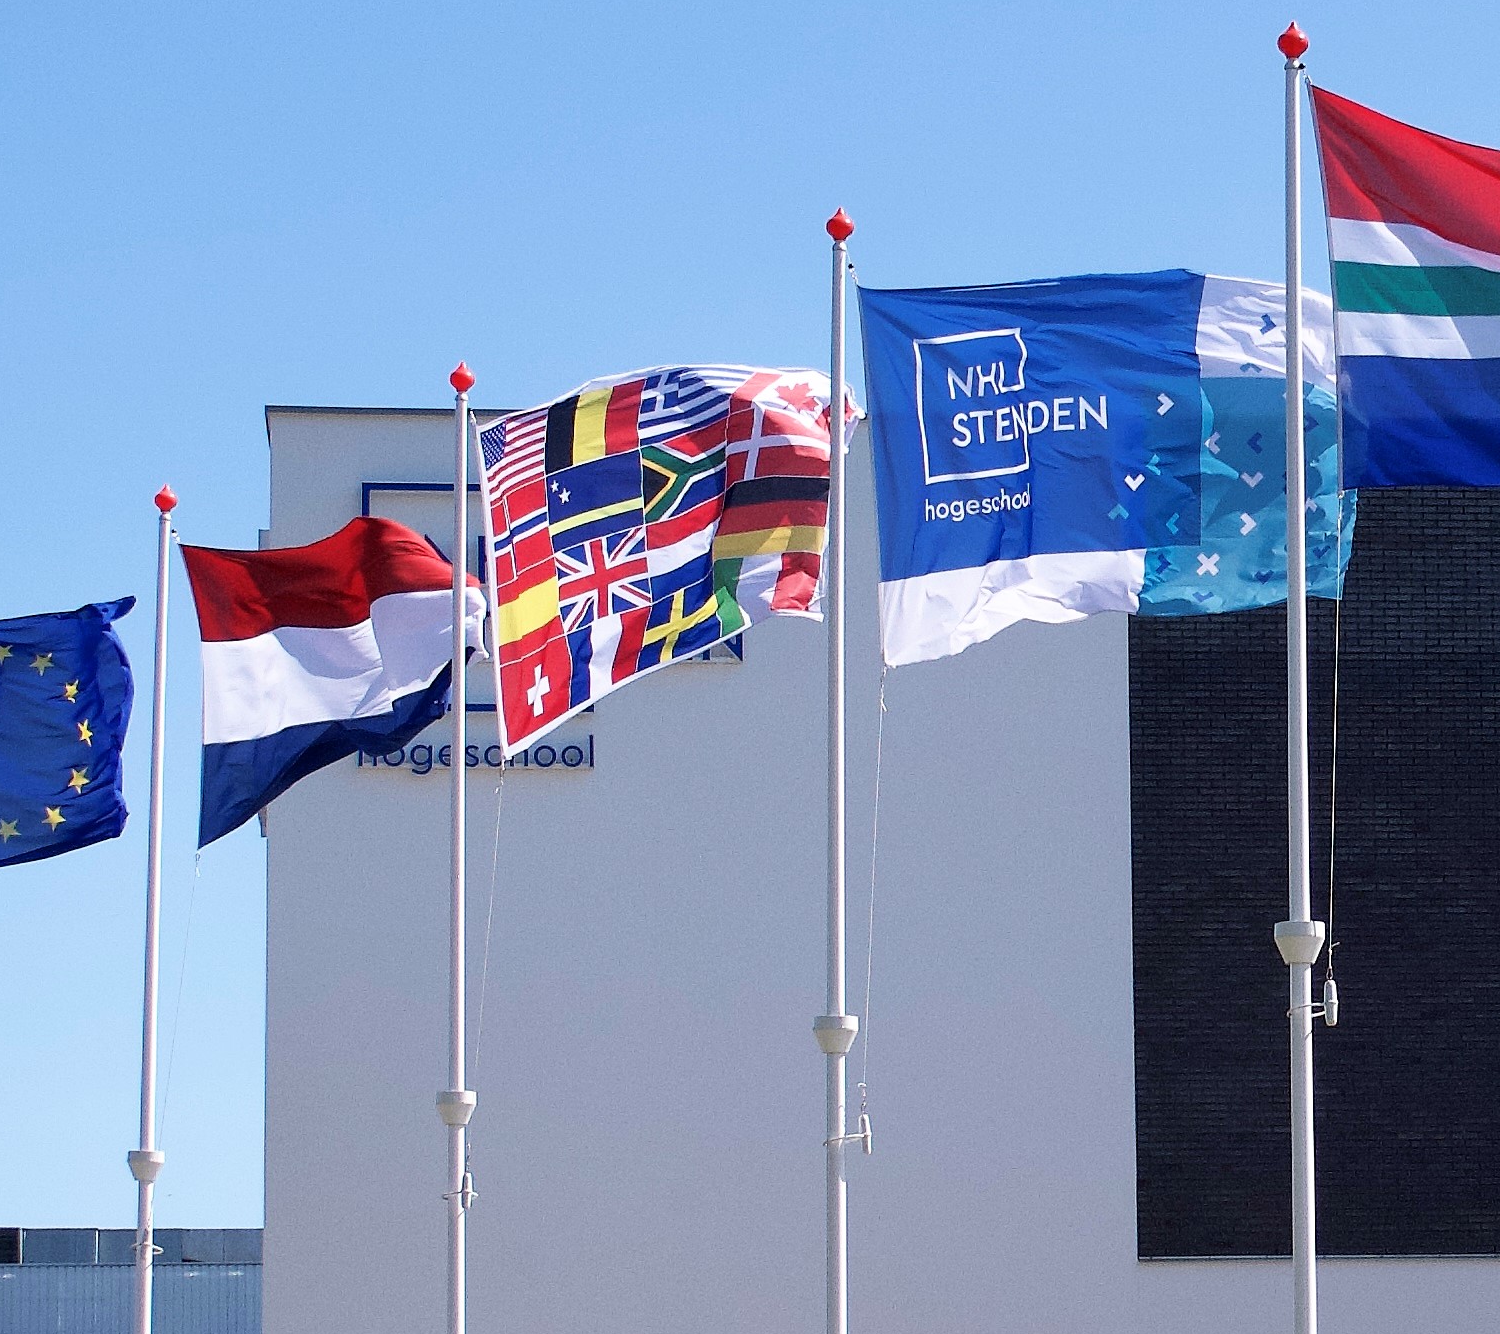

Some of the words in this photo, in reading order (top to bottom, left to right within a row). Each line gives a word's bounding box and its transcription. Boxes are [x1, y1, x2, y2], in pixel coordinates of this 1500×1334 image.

[947, 361, 1025, 399] NHL
[952, 395, 1110, 448] STENDEN
[924, 483, 1031, 522] hogeschool
